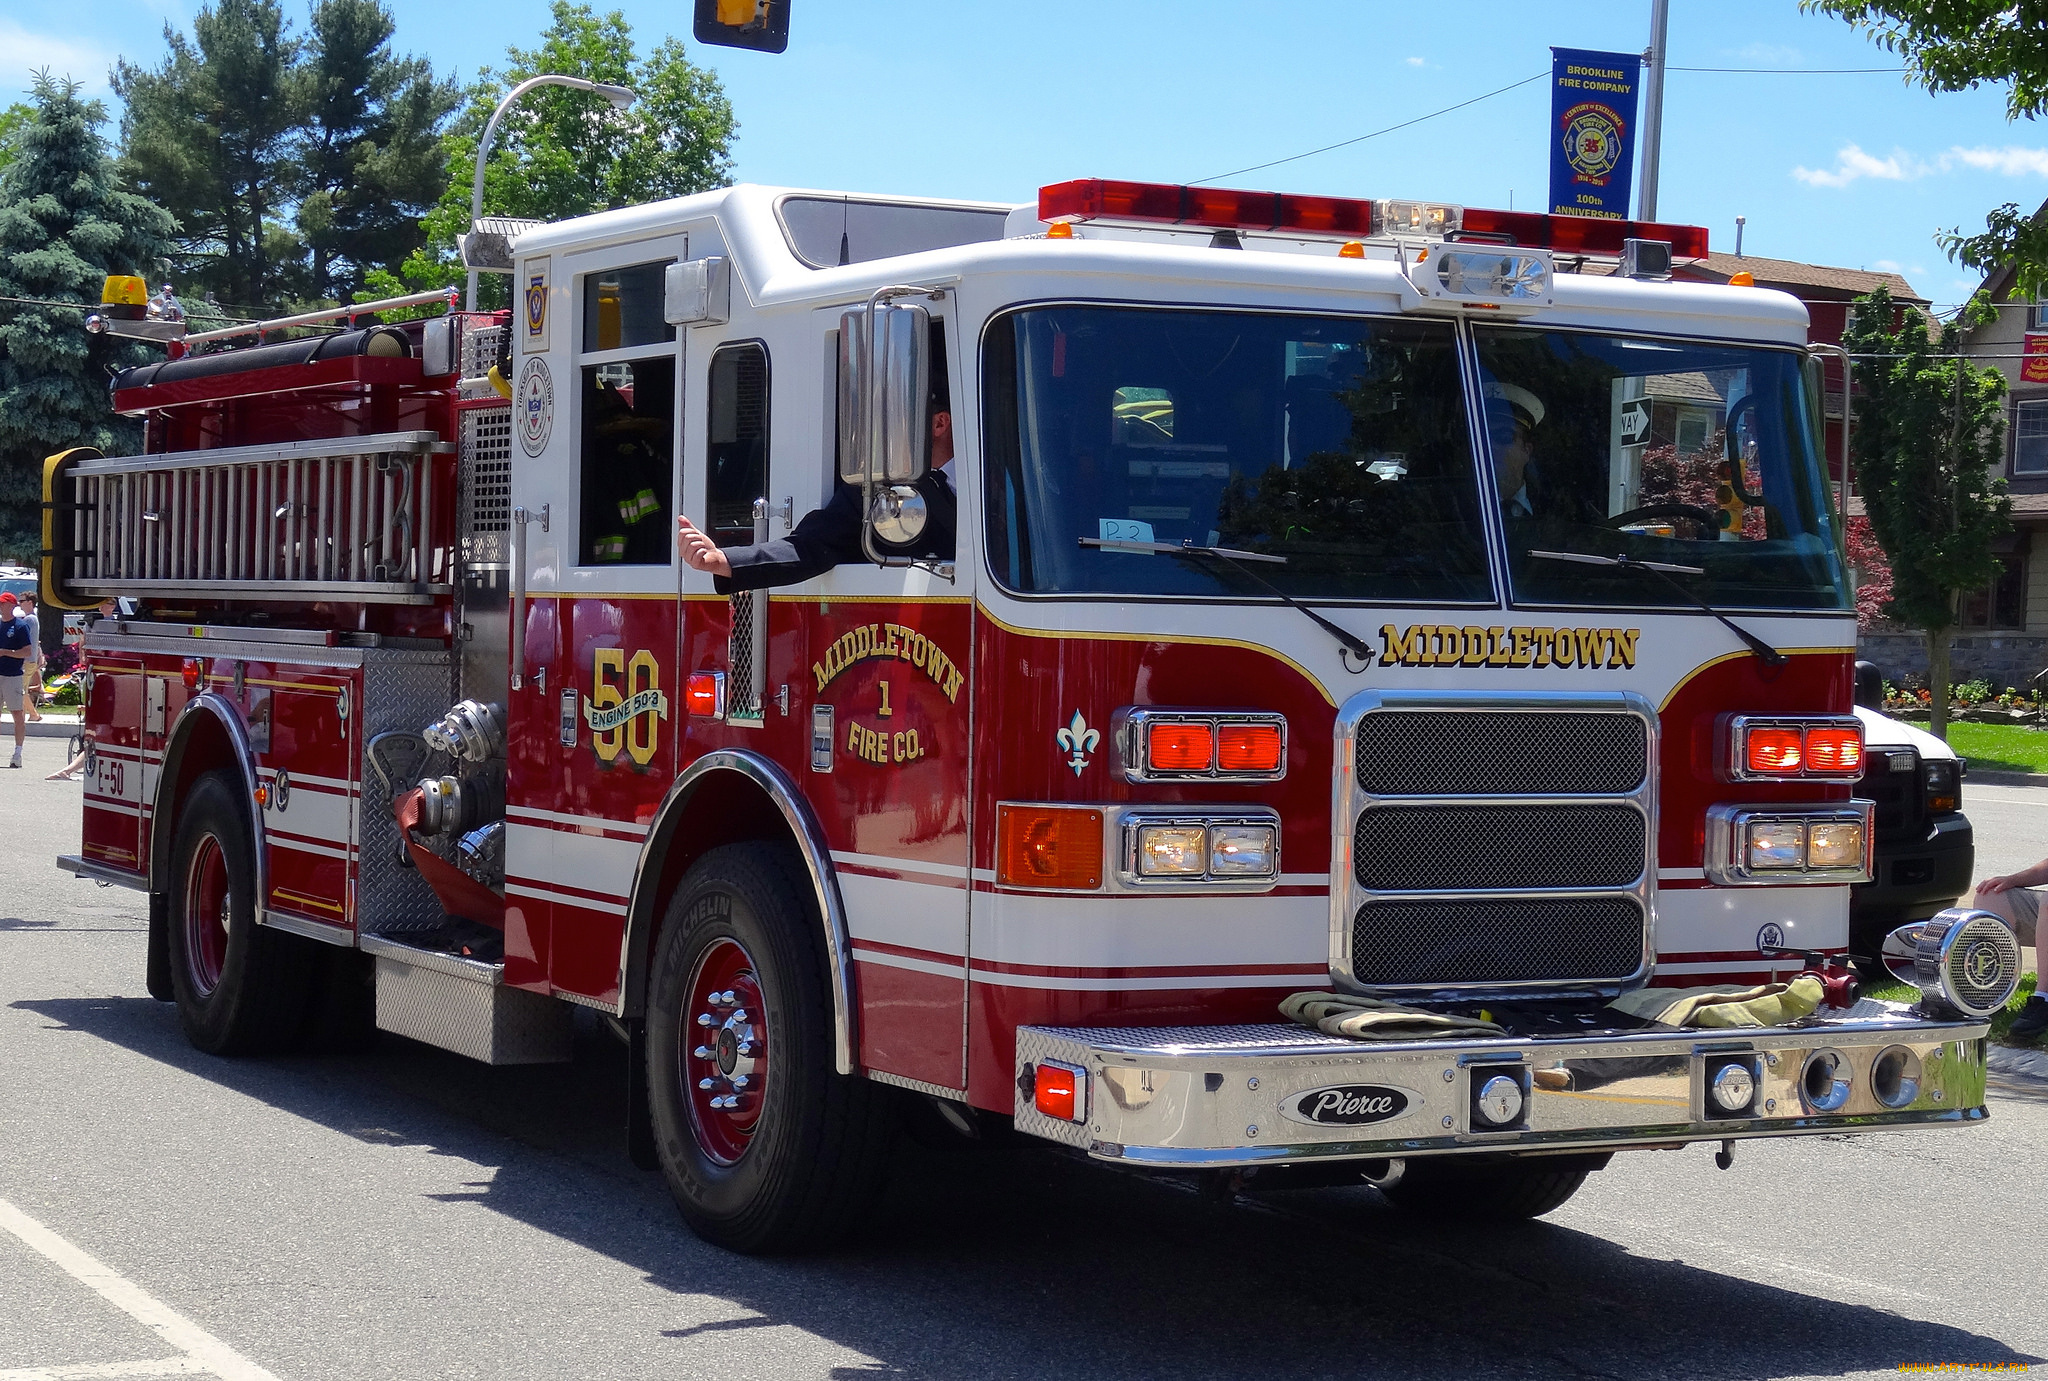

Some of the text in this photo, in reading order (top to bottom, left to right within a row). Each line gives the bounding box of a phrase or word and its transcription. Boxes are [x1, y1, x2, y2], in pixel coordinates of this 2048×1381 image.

[1558, 77, 1631, 94] FIRE COMPANY
[1567, 65, 1624, 80] BROOKLINE
[1566, 104, 1589, 118] CENTURY
[1595, 104, 1623, 127] EXCELLENCE
[1555, 205, 1623, 220] ANNIVERSARY
[1576, 194, 1603, 206] 100th
[812, 623, 965, 704] MIDDLETOWN
[1378, 624, 1640, 670] MIDDLETOWN
[591, 692, 659, 727] ENGINE 50-3
[593, 647, 660, 766] 50
[878, 680, 893, 716] 1
[847, 720, 924, 763] FIRE CO.
[98, 759, 124, 796] E-50
[668, 895, 731, 971] MICHELIN
[1311, 1090, 1393, 1121] Pierce
